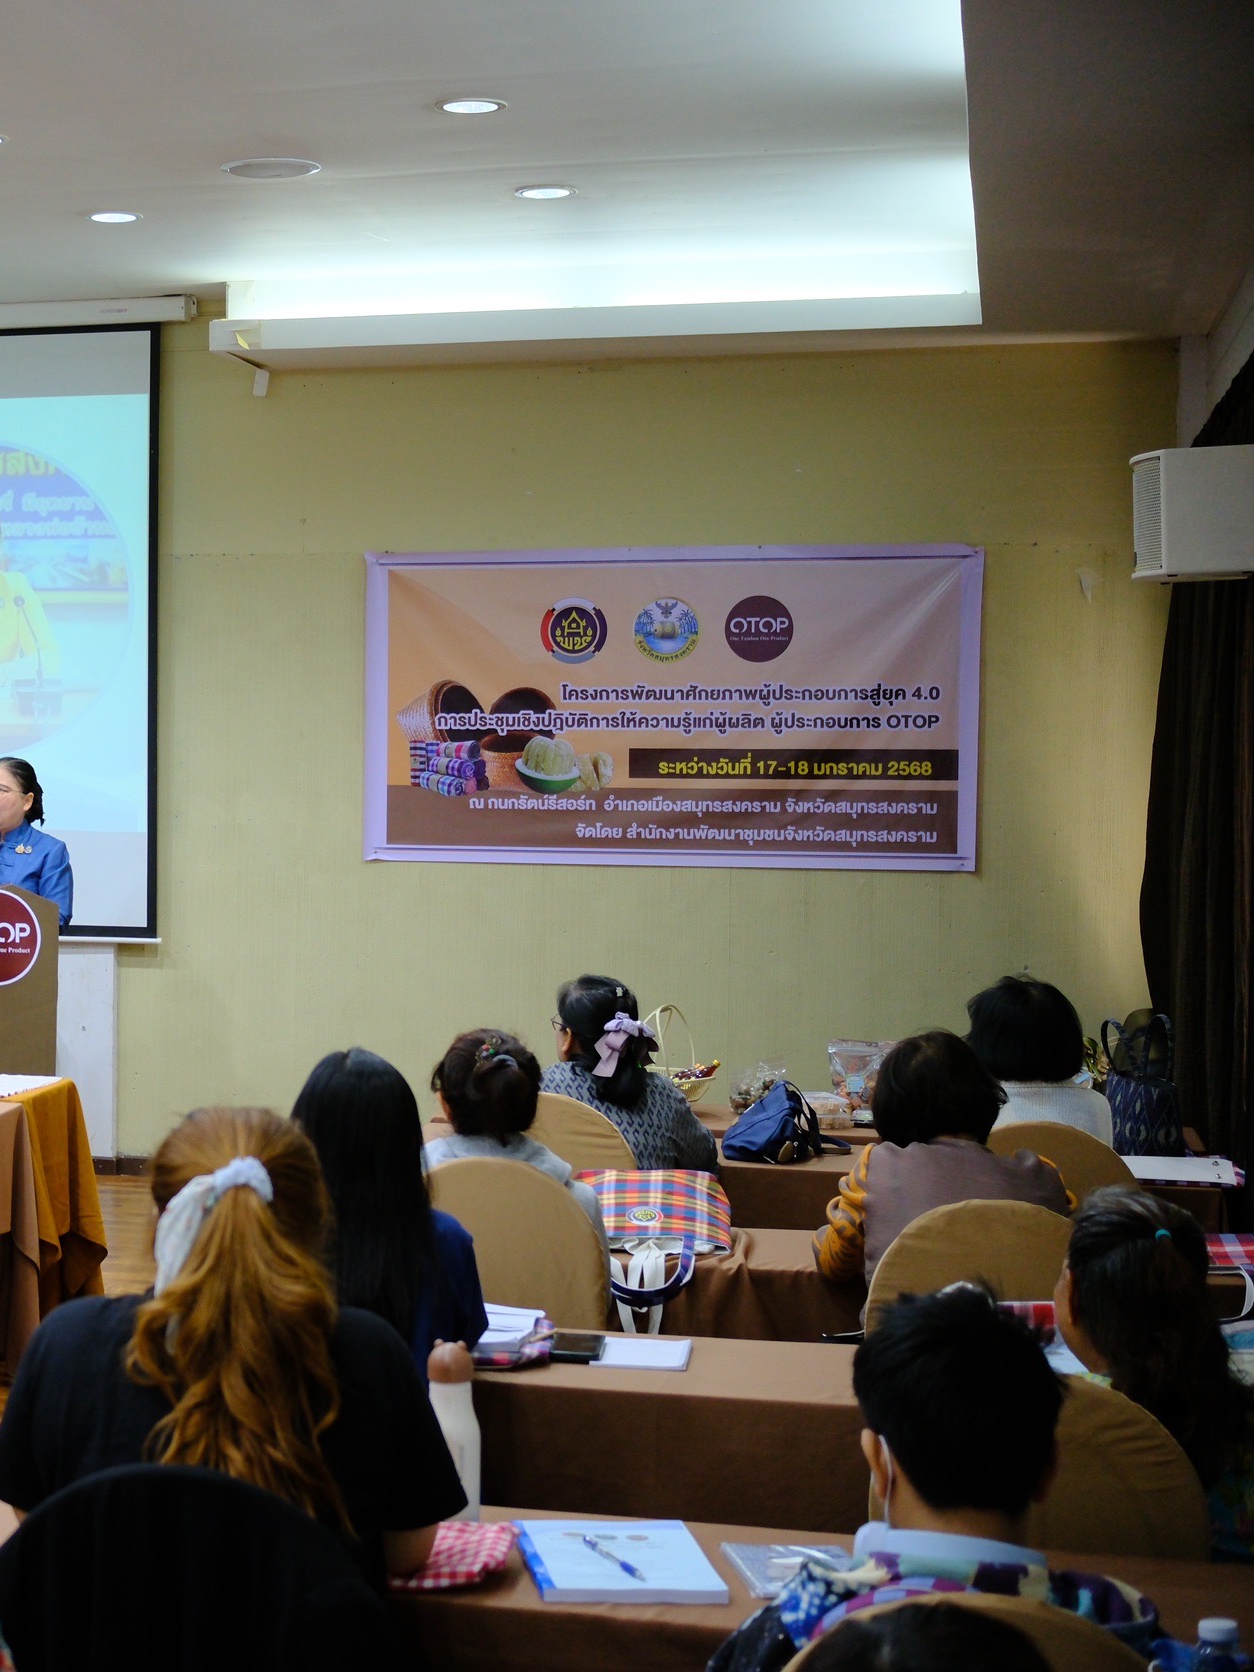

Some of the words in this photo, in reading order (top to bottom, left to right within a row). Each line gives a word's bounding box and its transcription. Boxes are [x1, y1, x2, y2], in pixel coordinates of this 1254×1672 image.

[729, 617, 789, 633] OTOP
[561, 683, 907, 707] โครงการพัฒนาศักยภาพผู้ประกอบการสู่ยุค
[911, 686, 941, 701] 4.0
[436, 711, 765, 734] การประชุมเชิงปฏิบัติการให้ความรู้แก่ผู้ผลิต
[770, 711, 882, 735] ผู้ประกอบการ
[886, 714, 941, 729] OTOP
[658, 752, 752, 776] ระหว่างวันที่
[756, 760, 809, 775] 17-18
[813, 760, 883, 776] มกราคม
[887, 761, 933, 776] 2568
[468, 796, 484, 809] ณ
[488, 794, 597, 811] กนกรัตน์รีสอร์ท
[603, 796, 781, 818] อำเภอเมืองสมุทรสงคราม
[785, 797, 938, 819] จังหวัดสมุทรสงคราม
[575, 822, 622, 839] จัดโดย
[626, 822, 938, 847] สำนักงานพัฒนาชุมชนจังหวัดสมุทรสงคราม
[8, 946, 31, 954] Product
